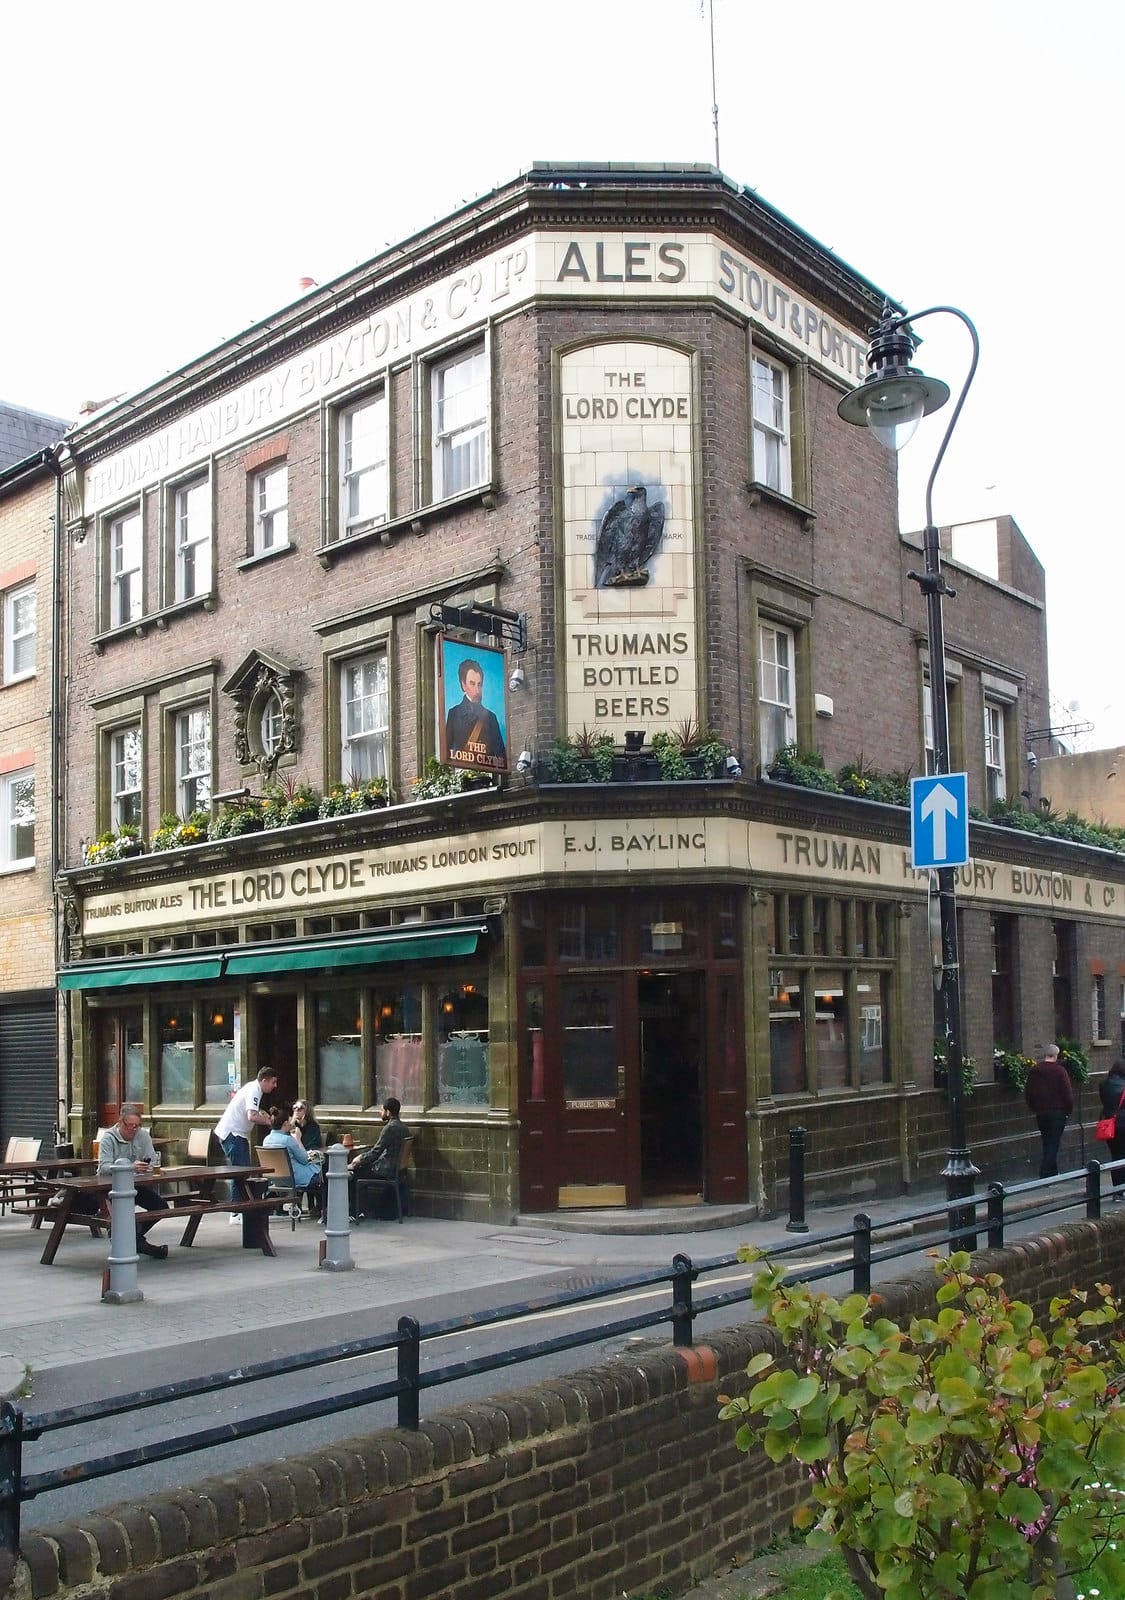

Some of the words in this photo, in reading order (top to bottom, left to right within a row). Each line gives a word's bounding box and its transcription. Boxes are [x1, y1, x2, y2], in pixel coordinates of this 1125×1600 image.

[557, 241, 687, 283] ALES
[604, 372, 646, 388] THE
[91, 434, 169, 503] TRUMAN
[177, 368, 291, 460] HANBURY
[298, 304, 412, 398] BUXTON
[420, 298, 438, 331] &
[566, 398, 619, 420] LORD
[625, 398, 688, 419] CLYDE
[571, 632, 689, 656] TRUMANS
[583, 665, 679, 687] BOTTLED
[594, 696, 670, 718] BEERS
[449, 749, 475, 762] LORD
[467, 741, 487, 754] THE
[564, 836, 602, 852] E.J.
[611, 833, 706, 851] BAYLING
[84, 904, 122, 921] TRUMANS
[124, 897, 158, 915] BURTON
[159, 894, 183, 908] ALES
[188, 881, 228, 910] THE
[232, 871, 286, 905] LORD
[290, 858, 366, 897] CLYDE
[368, 855, 428, 877] TRUMANS
[431, 846, 488, 869] LONDON
[492, 839, 536, 861] STOUT
[776, 832, 881, 875] TRUMAN
[1012, 869, 1072, 901] BUXTON
[1084, 881, 1093, 907] &
